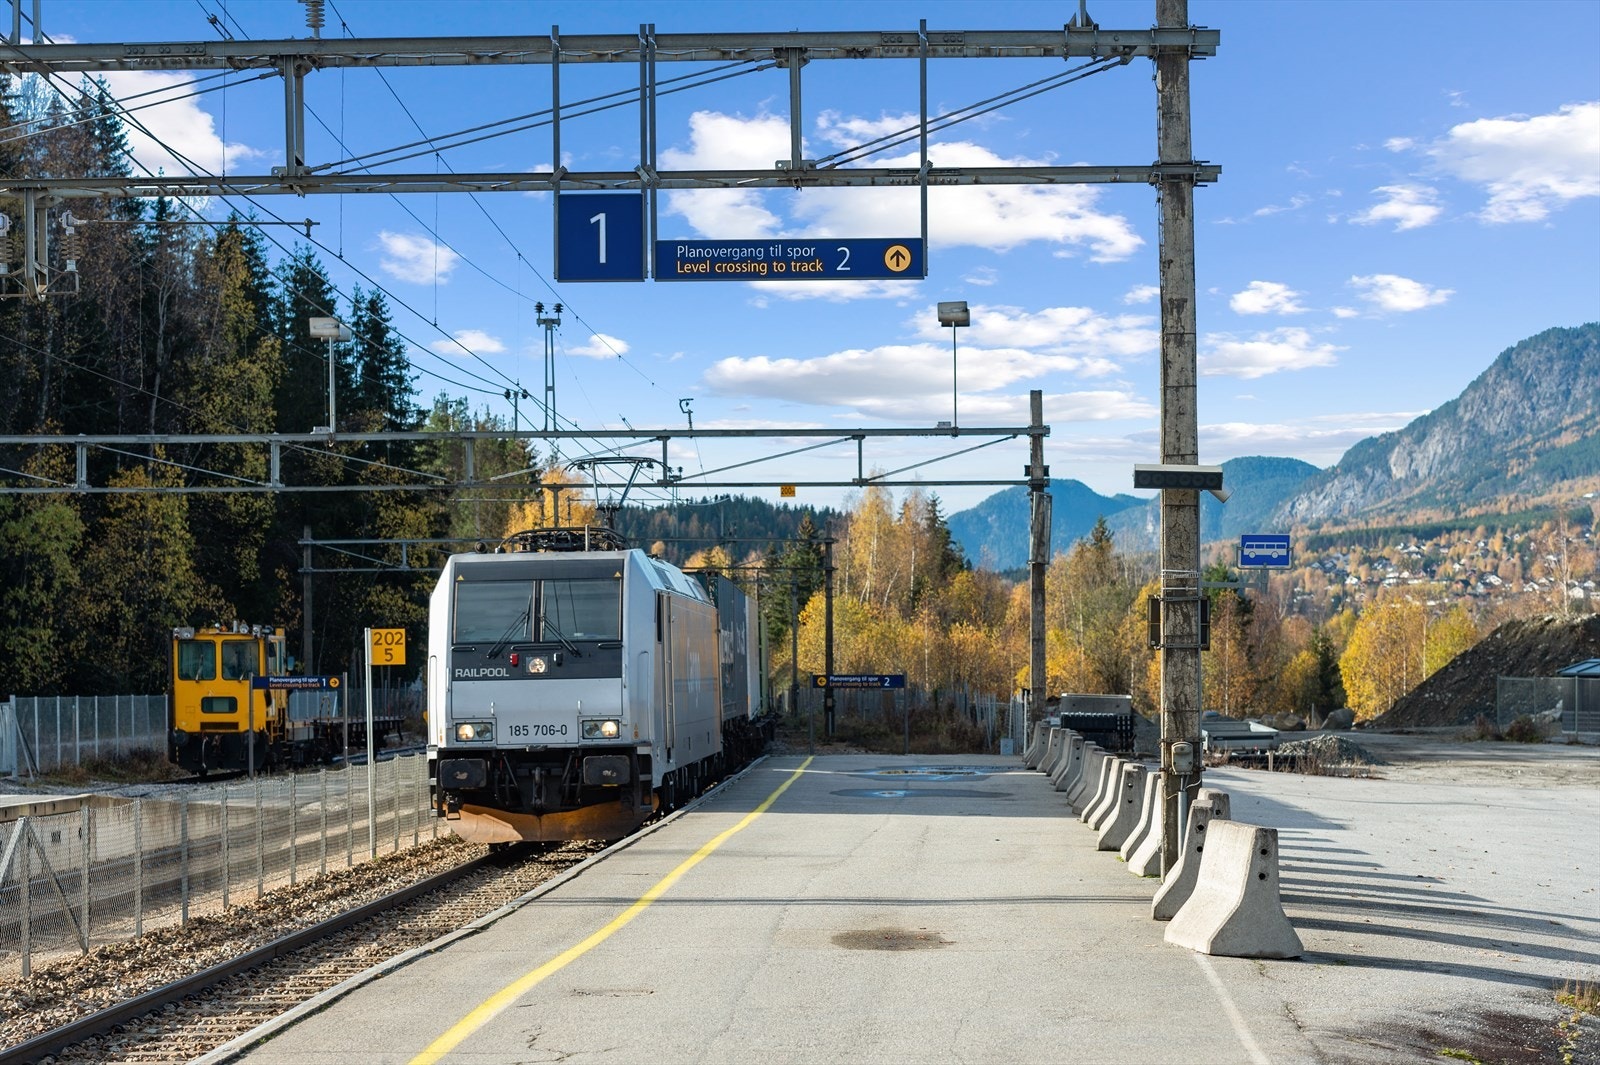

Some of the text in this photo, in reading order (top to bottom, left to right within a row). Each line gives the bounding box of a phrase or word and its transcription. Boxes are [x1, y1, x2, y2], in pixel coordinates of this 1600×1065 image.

[589, 212, 607, 264] 1
[677, 244, 816, 260] Planovergang til spor
[836, 246, 851, 271] 2
[677, 259, 824, 275] Level crossing to track
[373, 631, 404, 646] 202
[384, 647, 394, 662] 5
[455, 667, 510, 678] RAILPOOL
[322, 678, 326, 687] 1
[884, 677, 890, 686] 2
[509, 724, 568, 737] 185 706-0
